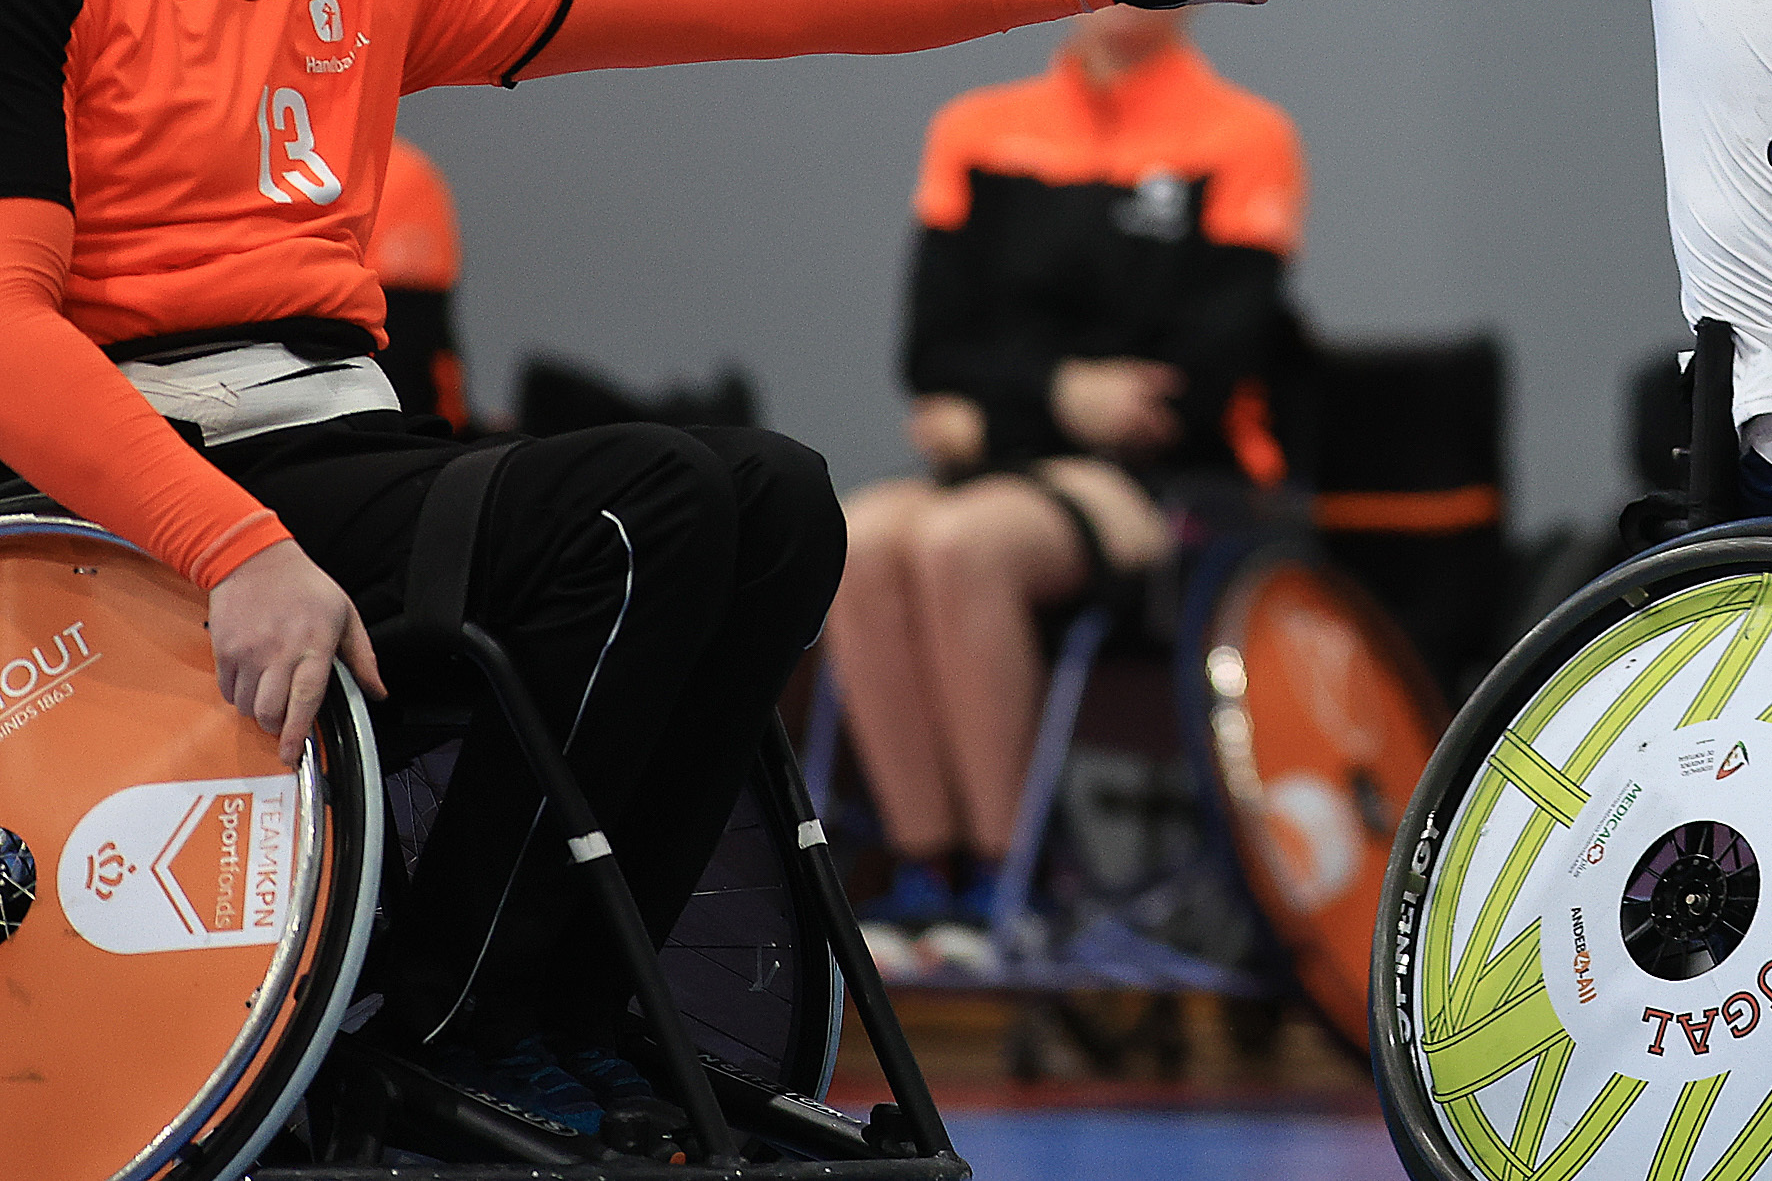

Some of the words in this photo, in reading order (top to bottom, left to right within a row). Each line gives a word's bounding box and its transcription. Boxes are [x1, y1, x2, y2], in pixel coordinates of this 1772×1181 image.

[258, 85, 342, 205] 13
[0, 622, 89, 710] OUT
[0, 705, 38, 739] INDS
[37, 682, 75, 713] 1863
[1594, 783, 1643, 845] MEDICAL
[214, 797, 246, 930] Sportfonds
